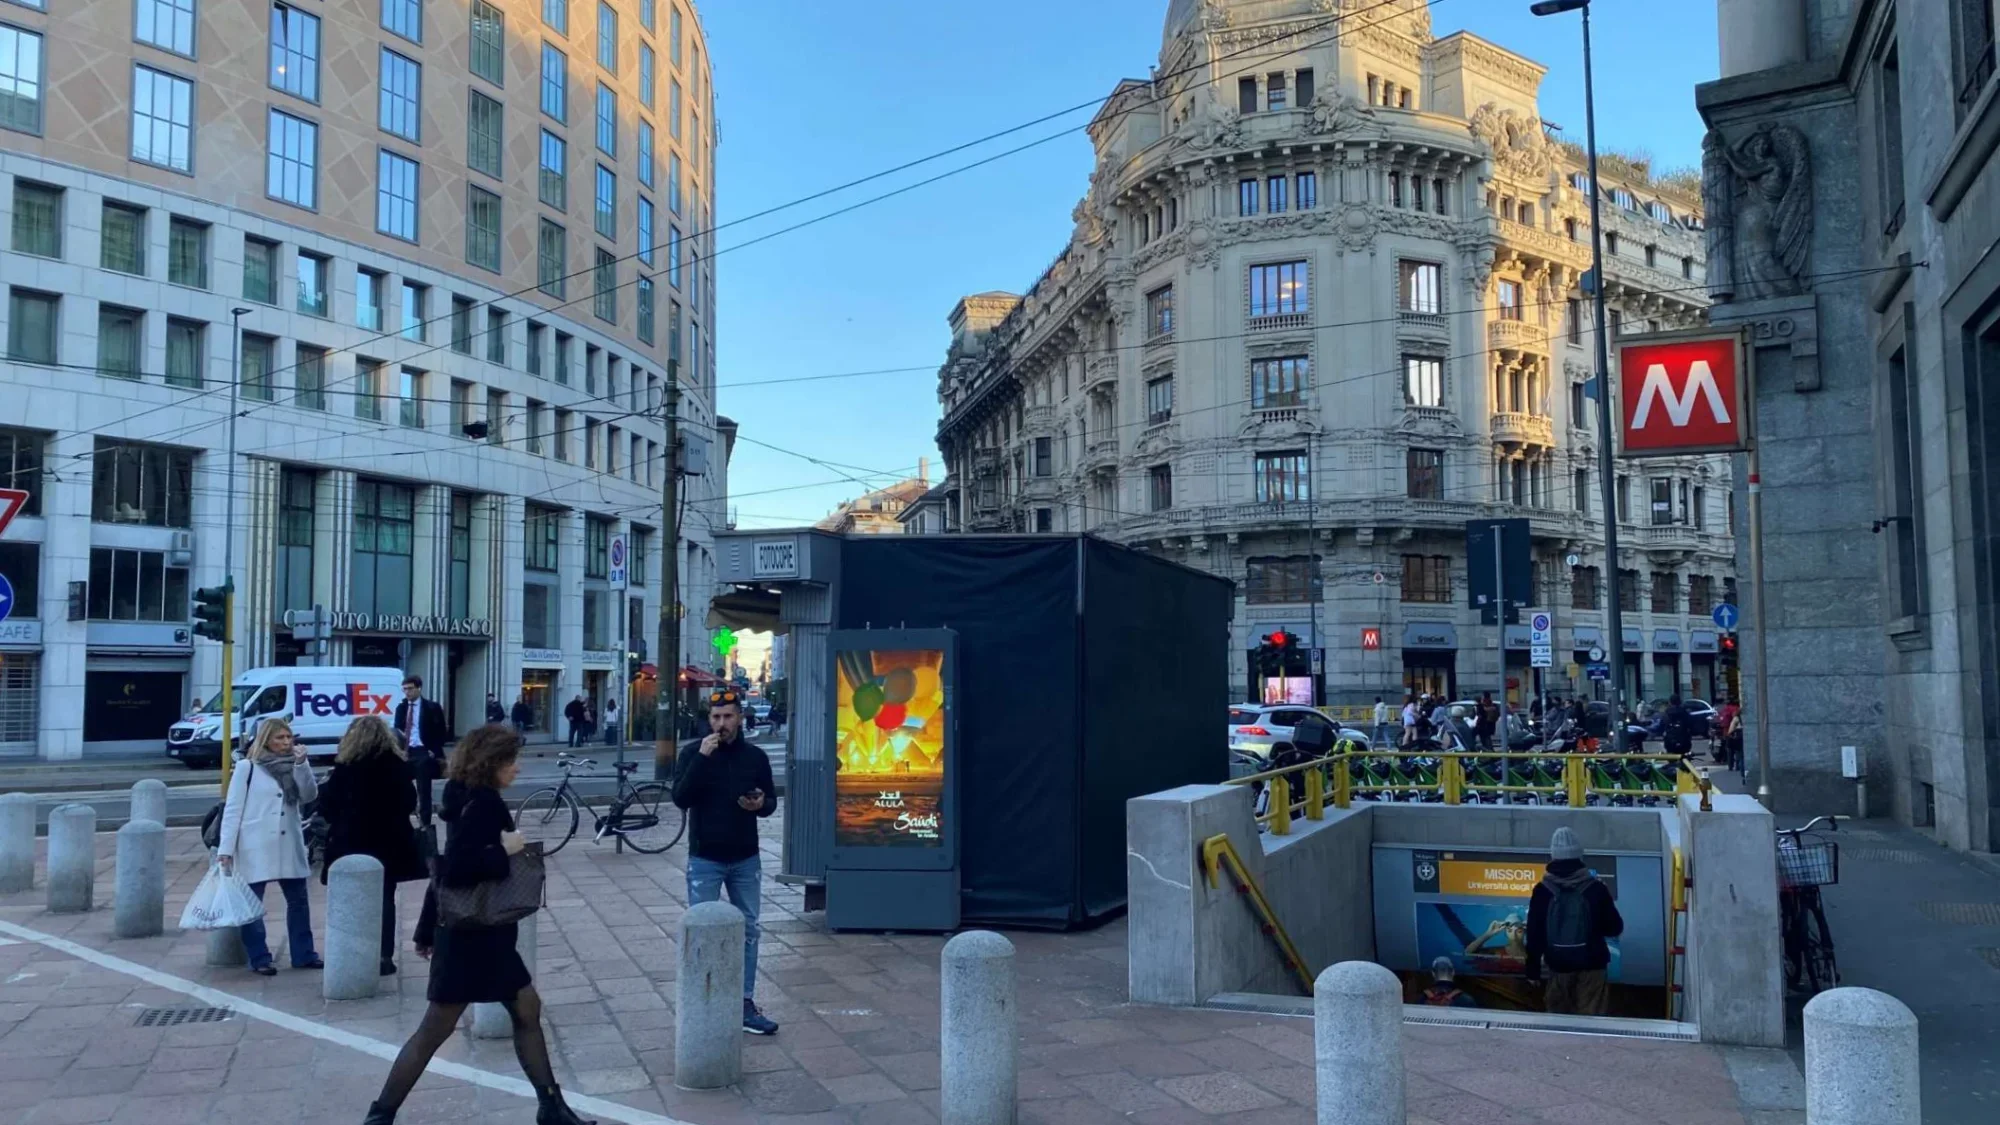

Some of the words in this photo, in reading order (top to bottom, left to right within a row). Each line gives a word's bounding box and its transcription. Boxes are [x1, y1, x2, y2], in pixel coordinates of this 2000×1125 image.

[1631, 360, 1731, 430] M
[760, 545, 793, 569] FOTOCOPIE
[284, 609, 370, 630] CITO
[377, 614, 492, 635] BERGAMASCO
[1364, 633, 1377, 645] M
[294, 683, 393, 717] FedEx
[894, 812, 938, 830] Saudi
[1484, 868, 1535, 880] MISSORI
[1468, 881, 1508, 890] Università
[1510, 882, 1530, 892] degli
